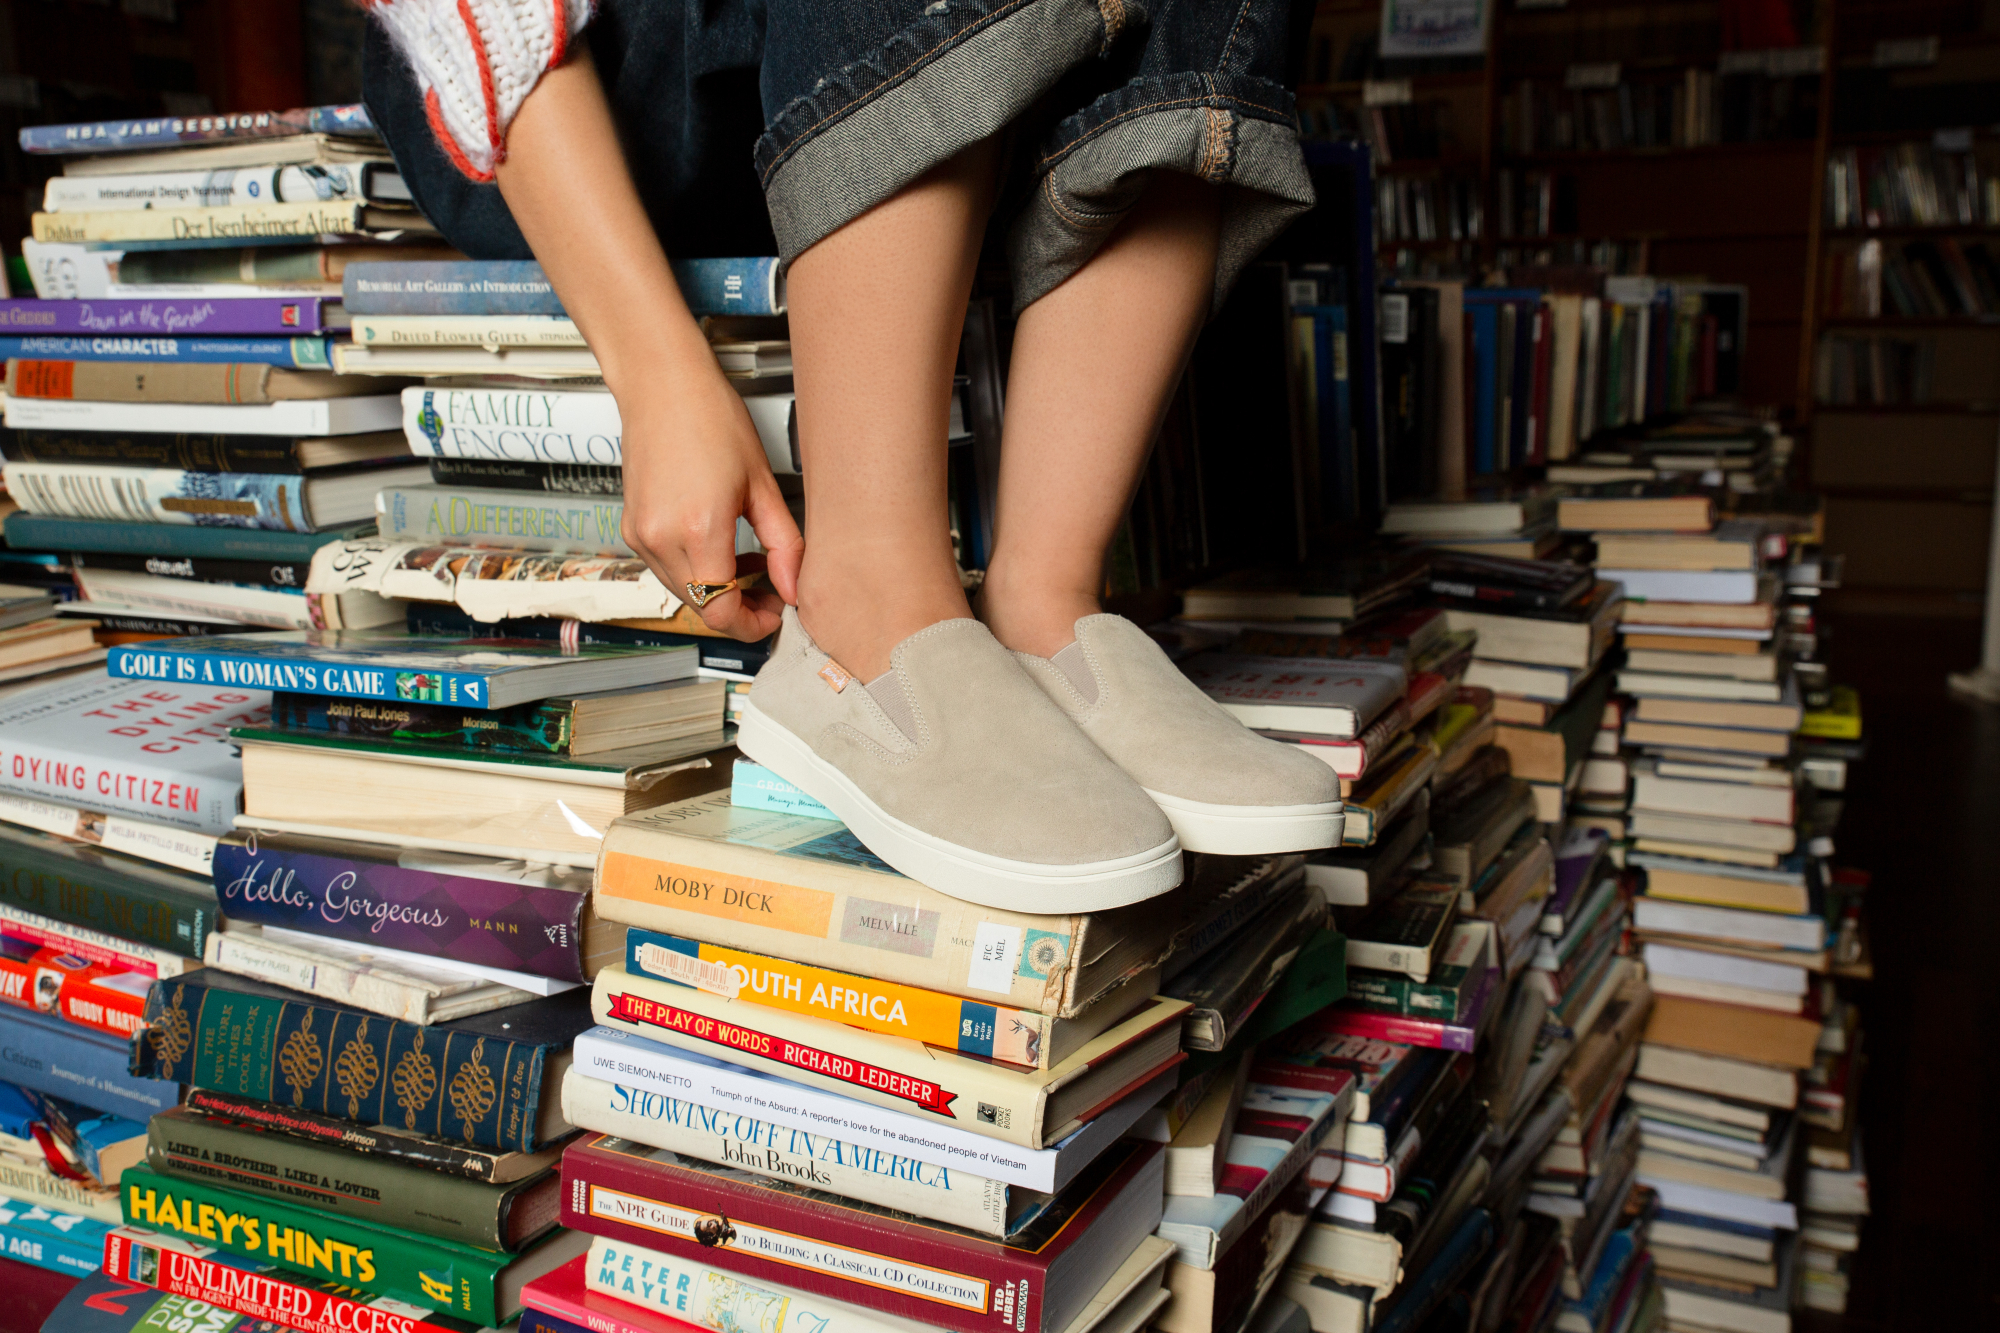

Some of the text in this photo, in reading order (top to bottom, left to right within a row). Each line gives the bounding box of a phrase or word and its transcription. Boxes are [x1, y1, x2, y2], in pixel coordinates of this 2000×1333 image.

[66, 112, 271, 140] NBA JAM SESSION
[98, 186, 156, 199] International
[160, 185, 189, 201] Design
[44, 211, 349, 240] DuMont Der Isenheimer Altar
[357, 279, 402, 293] MEMORIAL
[405, 279, 424, 293] ART
[468, 280, 482, 293] AN
[483, 279, 551, 293] INTRODUCTION
[79, 303, 216, 332] Down in the Garden
[391, 330, 527, 344] DRIED FLOWER GIFTS
[21, 337, 178, 356] AMERICAN CHARACTER
[448, 391, 562, 428] FAMILY
[452, 428, 623, 466] ENCYCLO
[426, 497, 446, 535] A
[449, 496, 591, 540] DIFFERENT
[119, 652, 458, 703] GOLF IS A WOMAN'S GAME HORN
[82, 690, 183, 719] THE
[327, 703, 499, 731] John Paul Jones Morison
[13, 755, 86, 791] DYING
[97, 771, 200, 813] CITIZEN
[12, 867, 51, 906] OF
[225, 859, 519, 934] Hello, Gorgeous MANN
[654, 874, 918, 937] MOBY DICK MELVILLE
[195, 909, 204, 958] MORROW
[559, 923, 568, 948] HMH
[983, 944, 993, 961] FIC
[995, 939, 1006, 962] MEL
[643, 960, 690, 980] Fodors South
[808, 981, 908, 1026] AFRICA
[204, 1027, 215, 1056] THE
[214, 1004, 233, 1085] NEW YORK
[228, 1025, 241, 1069] TIMES
[239, 1005, 260, 1093] COOK BOOK
[626, 997, 932, 1102] THE PLAY OF WORDS RICHARD LEDERER
[51, 1063, 85, 1085] Journeys
[86, 1076, 96, 1087] of
[98, 1080, 103, 1089] a
[104, 1079, 161, 1108] Humanitarian
[513, 1061, 525, 1085] Row
[194, 1094, 377, 1147] The History of Rasselas Prince of Abyssinia Johnson
[507, 1103, 520, 1141] Harper
[593, 1056, 1027, 1171] UWE SIEMON-NETTO Triumph of the Absurd: A reporter's love for the abandoned people of Vietnam
[997, 1106, 1005, 1128] POCKET
[1004, 1107, 1012, 1130] BOOKS
[610, 1083, 953, 1191] SHOWING OFF IN AMERICA
[167, 1141, 198, 1159] LIKE
[200, 1148, 212, 1162] A
[284, 1166, 315, 1185] LIKE
[319, 1174, 331, 1188] A
[335, 1180, 381, 1200] LOVER
[167, 1159, 276, 1190] GEORGES-MICHEL
[721, 1139, 832, 1186] John Brooks
[572, 1178, 580, 1213] SECOND
[579, 1180, 587, 1215] EDITION
[9, 1236, 43, 1261] AGE
[130, 1185, 262, 1250] HALEY'S
[267, 1222, 377, 1283] HINTS
[597, 1200, 612, 1212] THE
[651, 1210, 690, 1231] GUIDE
[741, 1234, 756, 1246] TO
[759, 1237, 810, 1260] BUILDING
[812, 1252, 820, 1263] A
[823, 1252, 881, 1278] CLASSICAL
[883, 1267, 904, 1283] CD
[906, 1273, 979, 1301] COLLECTION
[108, 1236, 122, 1276] ALDRICH
[602, 1248, 691, 1293] PETER
[169, 1253, 313, 1317] UNLIMITED
[319, 1297, 414, 1333] ACCESS
[169, 1280, 183, 1293] AN
[184, 1283, 200, 1296] FBI
[201, 1288, 233, 1307] AGENT
[235, 1297, 268, 1317] INSIDE
[270, 1308, 290, 1325] THE
[598, 1267, 688, 1312] MAYLE
[994, 1287, 1003, 1312] TED
[1003, 1280, 1016, 1325] LIBBEY
[1017, 1282, 1028, 1329] WORKMAN
[588, 1315, 616, 1333] WINE
